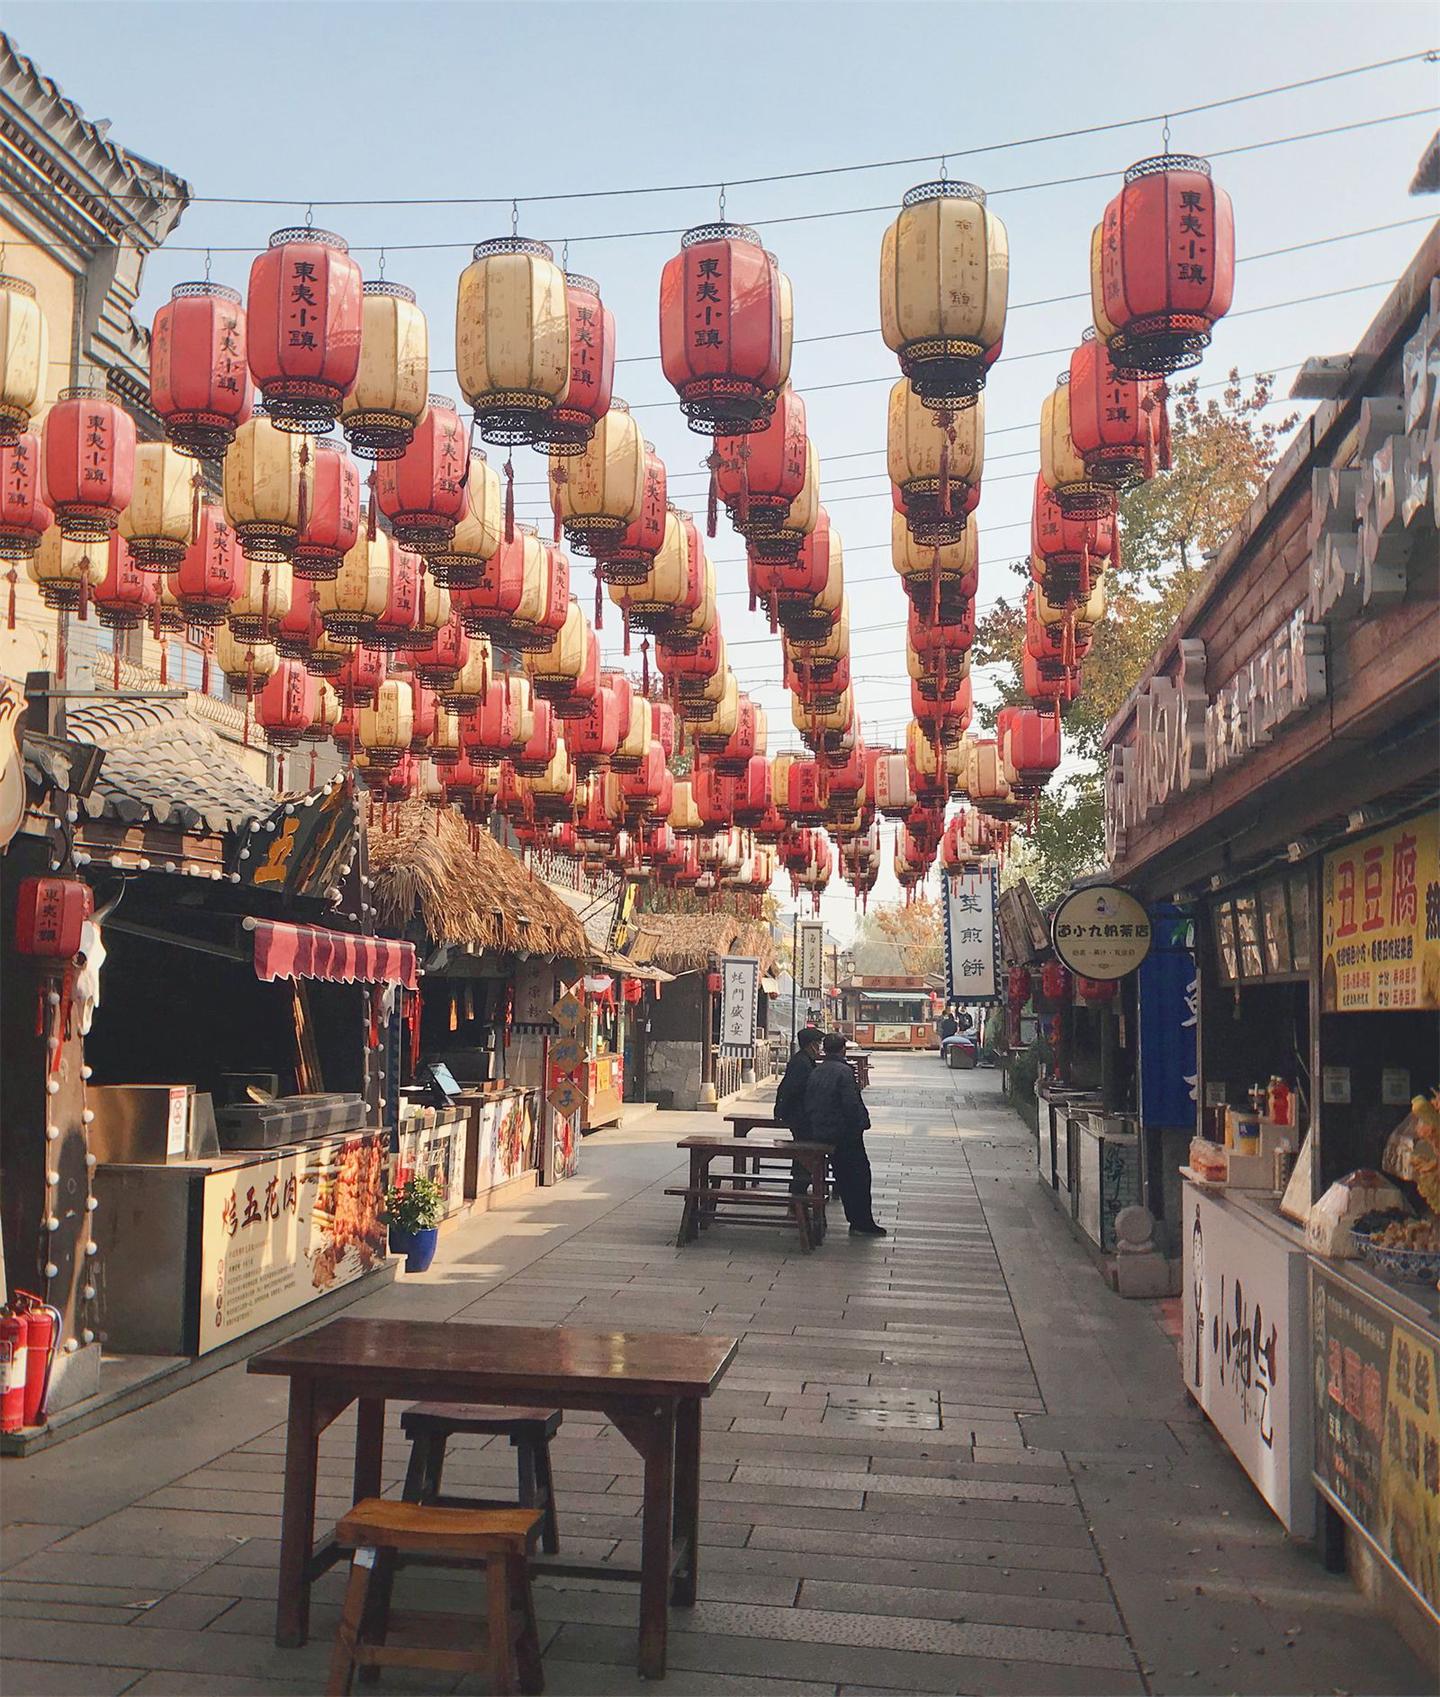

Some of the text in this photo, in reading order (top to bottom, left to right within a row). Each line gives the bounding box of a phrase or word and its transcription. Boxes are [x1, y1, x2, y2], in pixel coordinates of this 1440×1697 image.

[1177, 190, 1206, 285] 東夷小鎮
[288, 261, 318, 351] 東夷小鎮
[694, 258, 723, 350] 東夷小鎮
[571, 306, 595, 388] 東夷小鎮
[8, 445, 29, 507] 東夷小鎮
[84, 415, 107, 484] 東夷小鎮
[211, 522, 230, 581] 東夷小鎮
[959, 894, 985, 976] 菜煎餅
